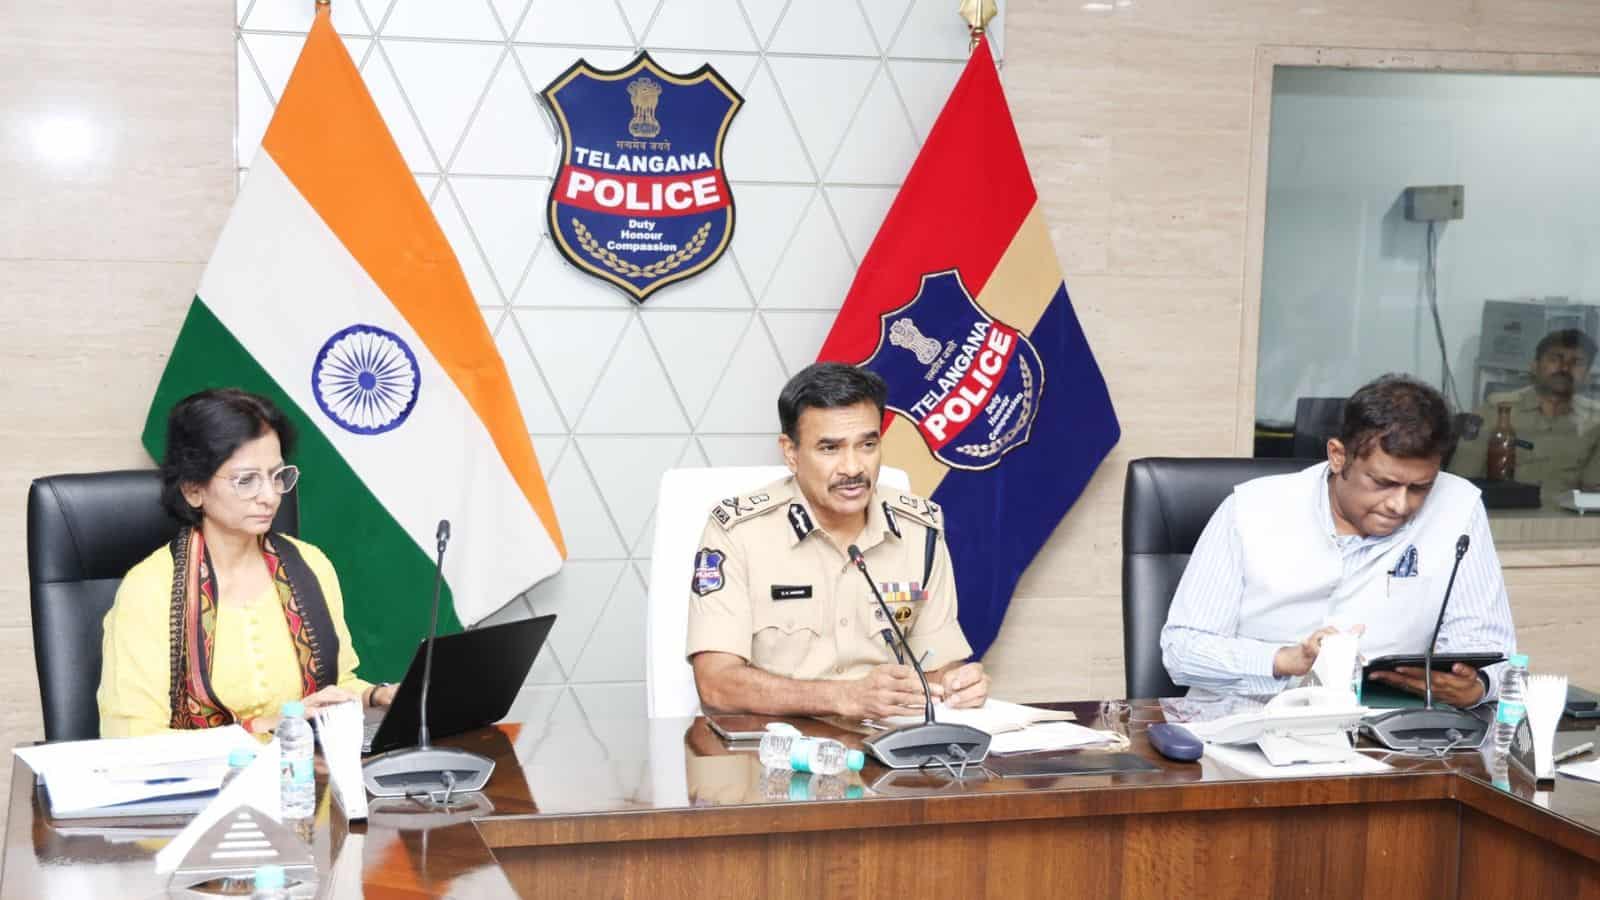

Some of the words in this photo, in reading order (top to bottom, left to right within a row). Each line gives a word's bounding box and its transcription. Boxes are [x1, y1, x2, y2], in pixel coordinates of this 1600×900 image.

[575, 146, 713, 173] TELANGANA
[565, 170, 721, 211] POLICE
[620, 229, 664, 240] Honour
[628, 219, 656, 231] Duty
[606, 240, 678, 253] Compassion
[910, 320, 991, 418] TELANGANA
[923, 327, 1013, 442] POLICE
